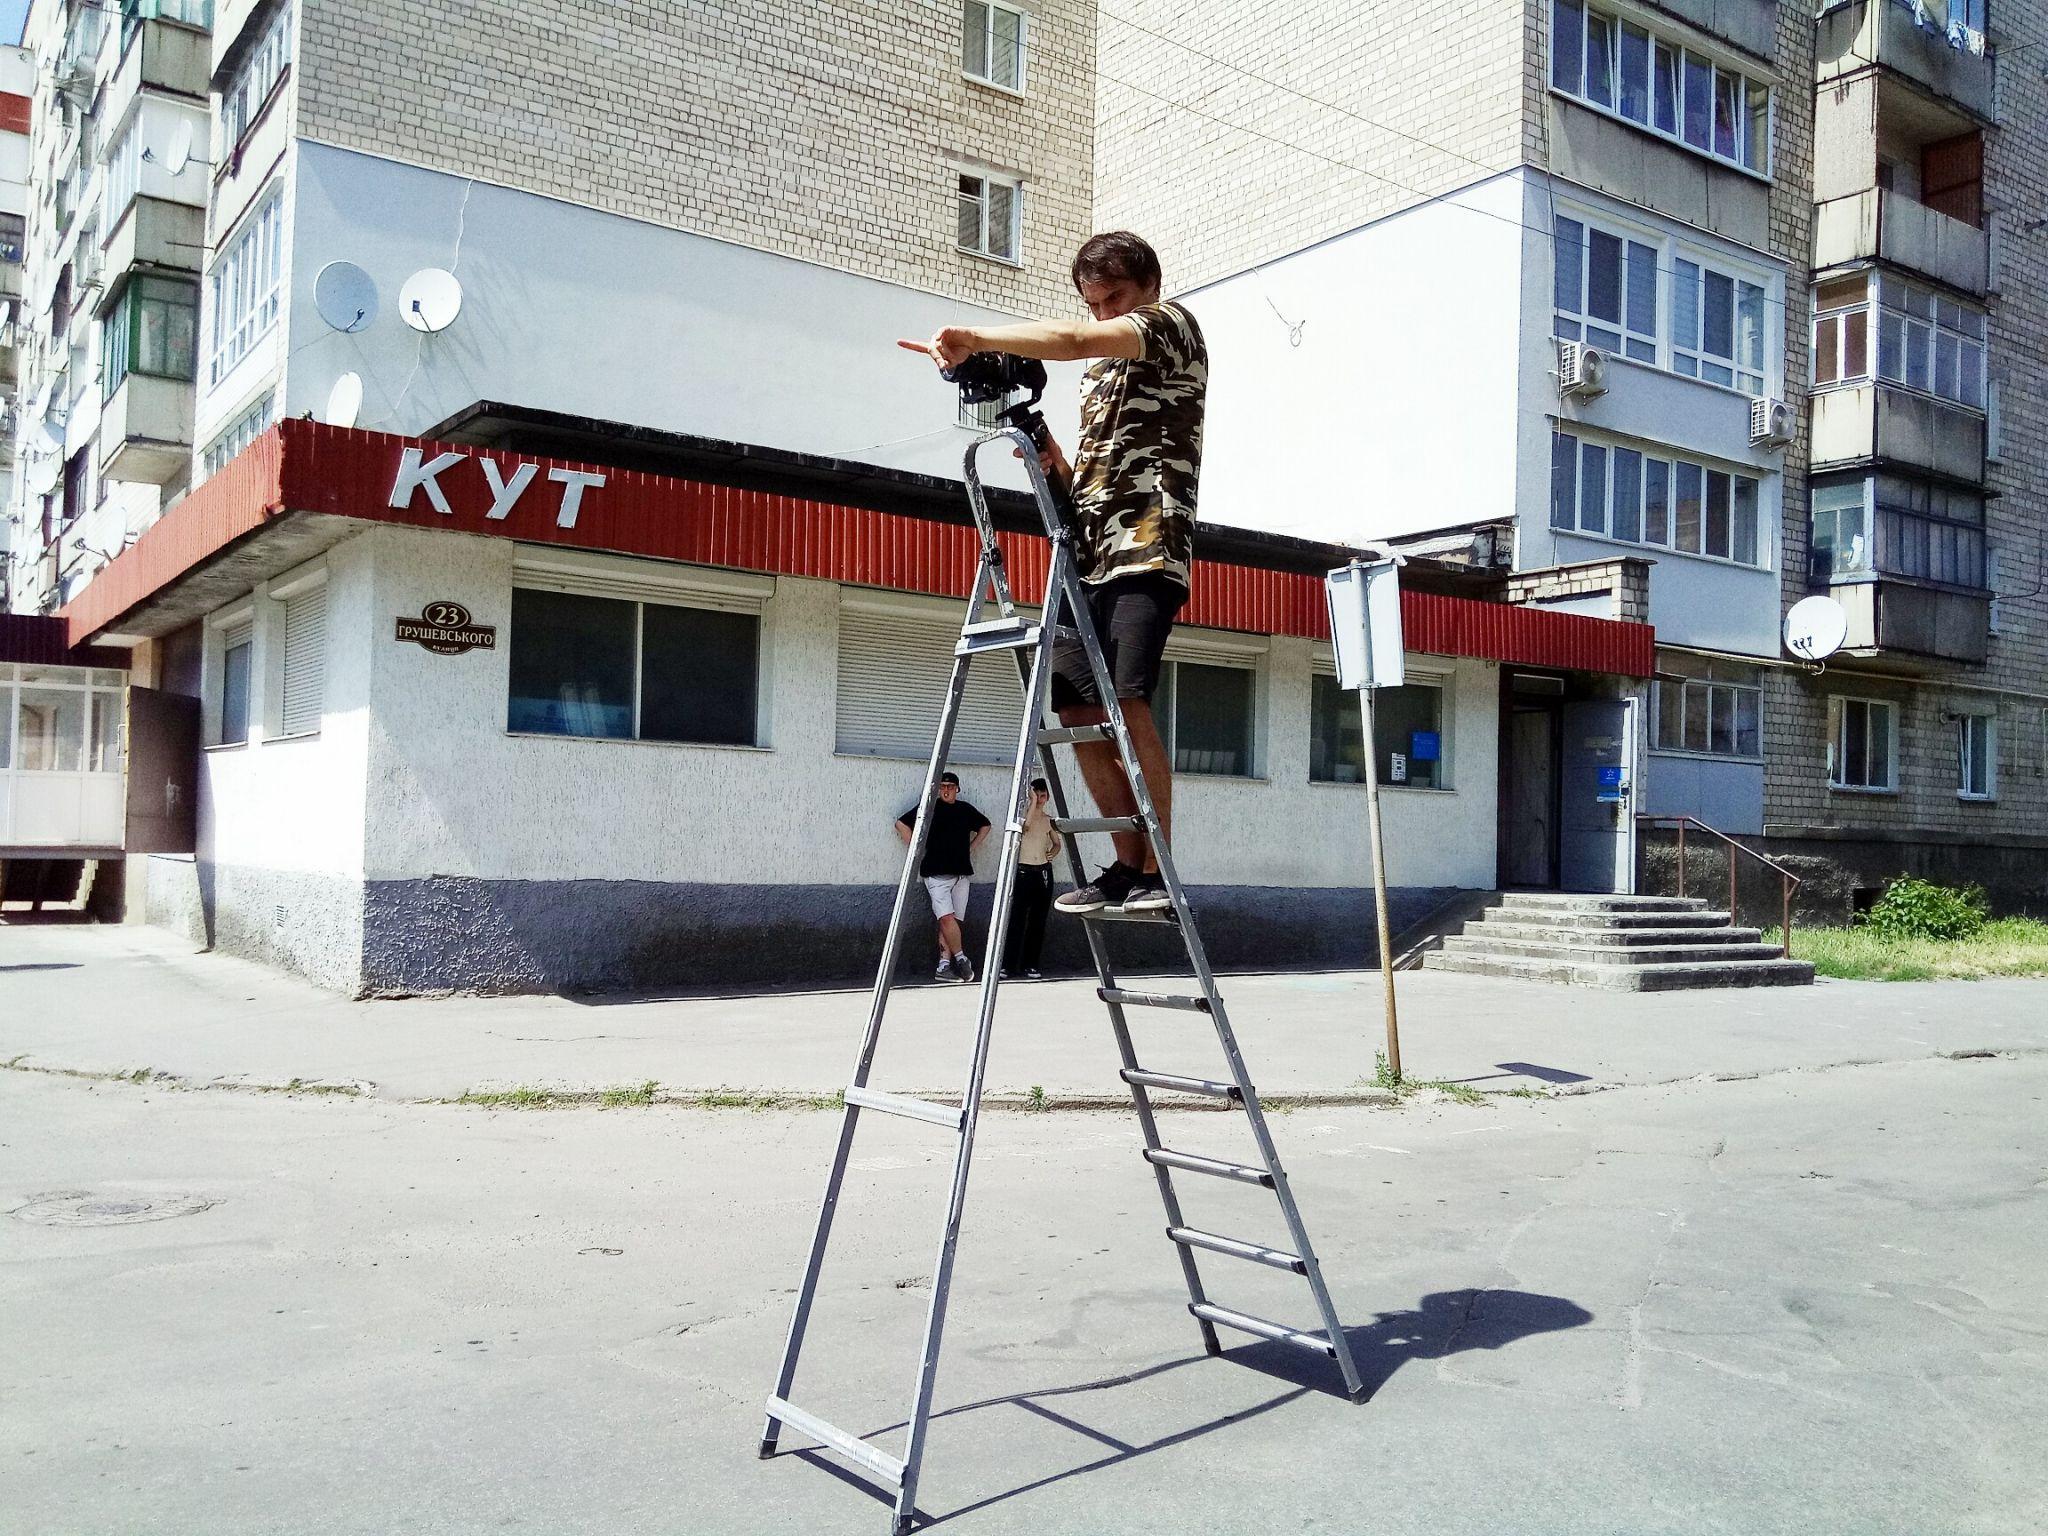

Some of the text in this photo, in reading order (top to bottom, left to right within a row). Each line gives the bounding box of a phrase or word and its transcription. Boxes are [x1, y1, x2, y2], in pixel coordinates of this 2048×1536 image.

[388, 447, 607, 529] КУТ
[435, 606, 459, 625] 23
[398, 625, 493, 645] ГРУШЕВСЬКОГО
